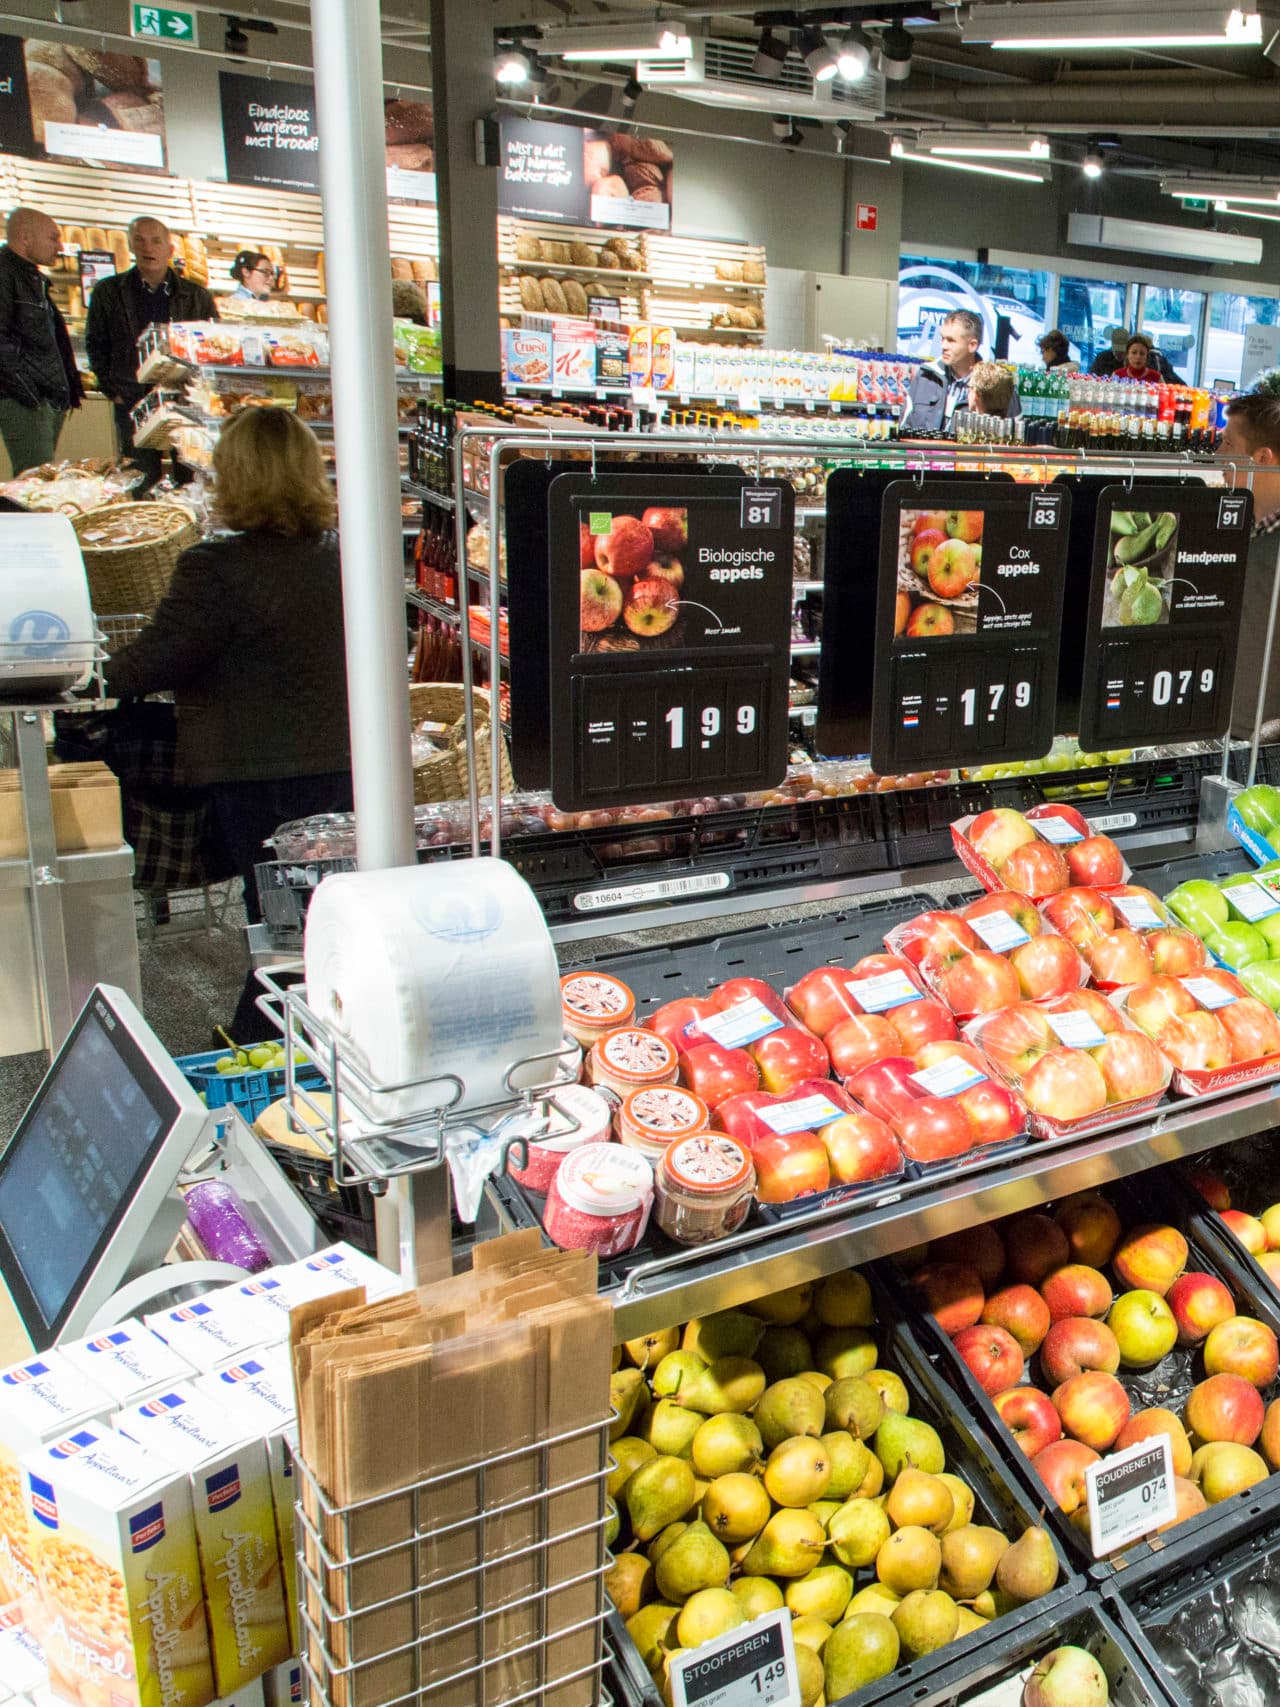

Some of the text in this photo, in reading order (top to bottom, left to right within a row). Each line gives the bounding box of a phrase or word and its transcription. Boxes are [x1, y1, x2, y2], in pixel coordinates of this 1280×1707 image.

[249, 103, 310, 122] Eindeloos
[245, 135, 320, 152] met brood?
[748, 506, 771, 524] 81
[1035, 510, 1056, 525] 83
[1222, 511, 1238, 525] 91
[698, 548, 775, 566] Biologische
[1009, 546, 1030, 559] Cox
[1177, 551, 1237, 566] Handperen
[709, 565, 764, 583] appels
[997, 562, 1040, 577] appels
[595, 892, 622, 903] 10604
[1096, 1449, 1163, 1487] GOUDRENETTE
[210, 1483, 238, 1502] Perfekt
[1097, 1490, 1105, 1499] N
[135, 1521, 162, 1543] Perfekt
[213, 1529, 263, 1667] Appeltaart
[137, 1567, 186, 1707] Appeltaart
[684, 1633, 770, 1683] STOOFPEREN
